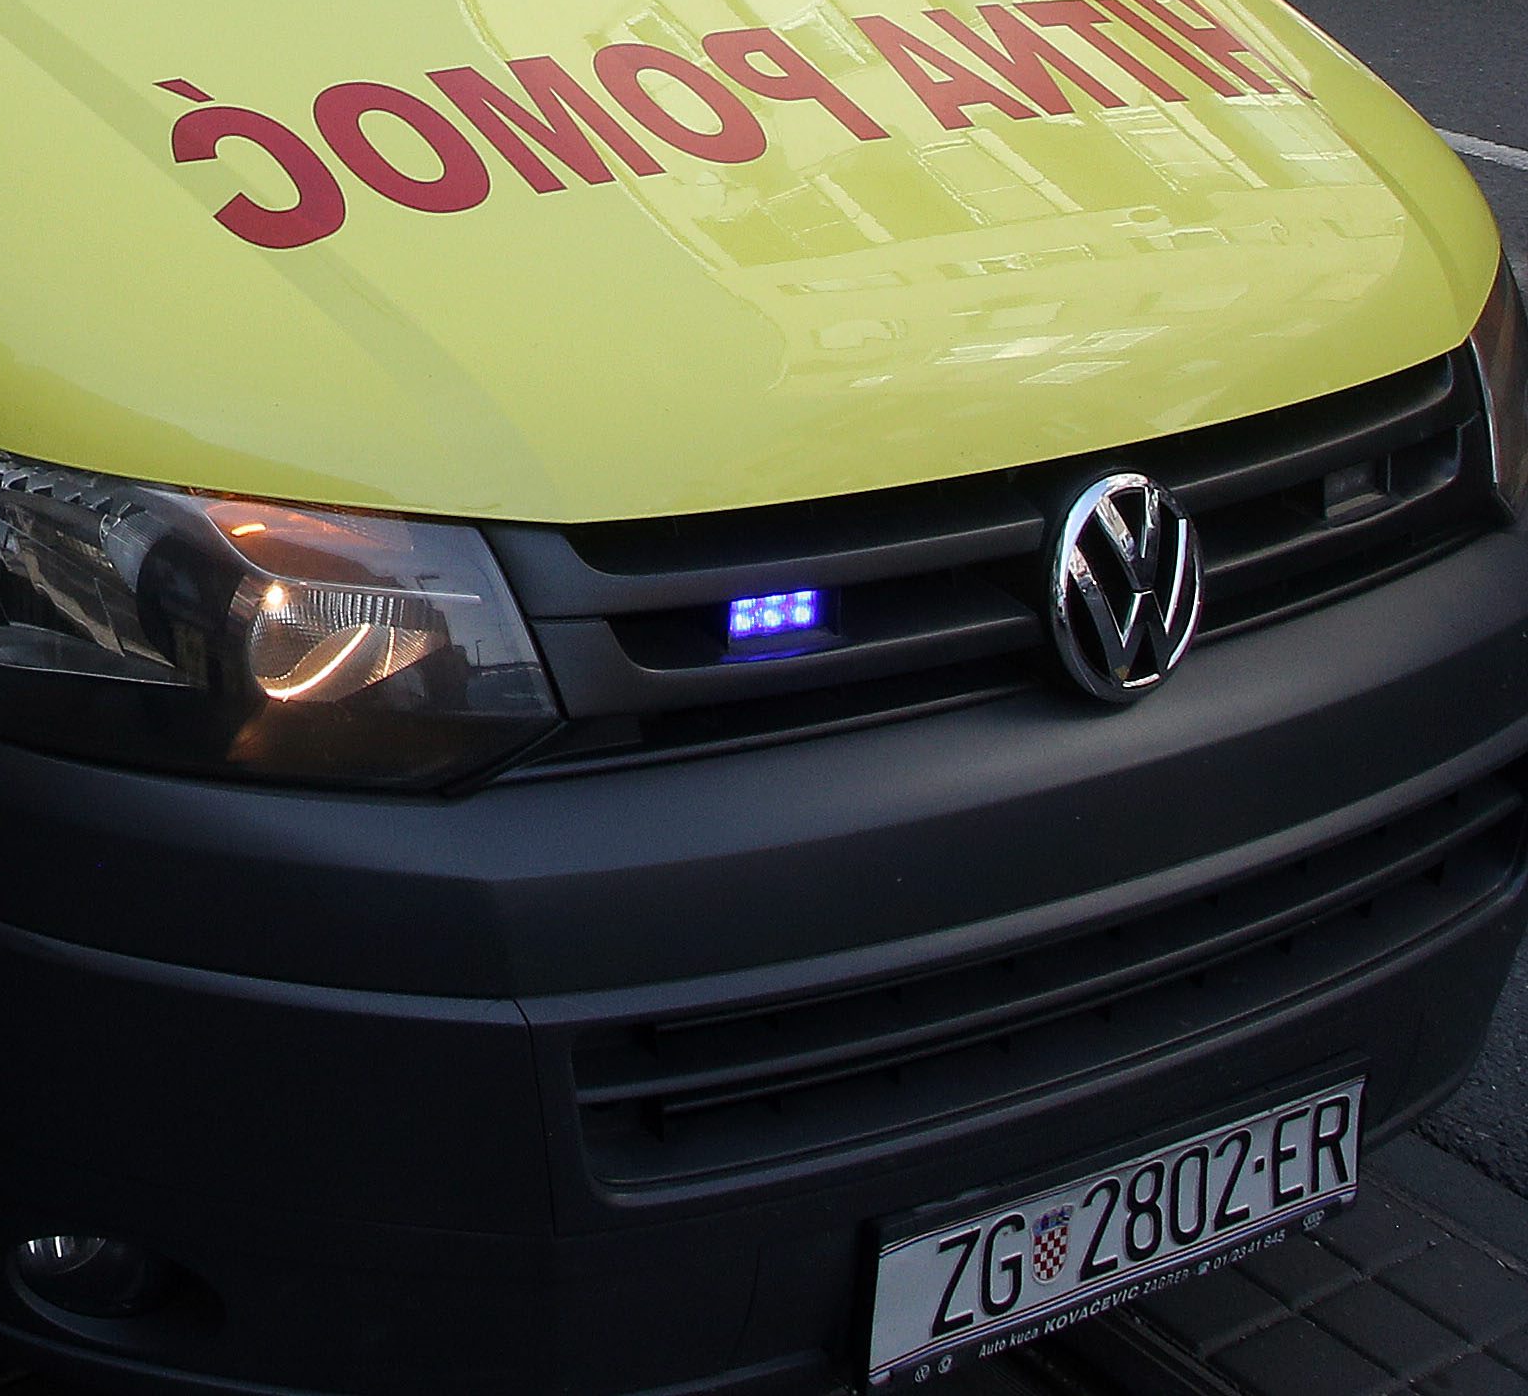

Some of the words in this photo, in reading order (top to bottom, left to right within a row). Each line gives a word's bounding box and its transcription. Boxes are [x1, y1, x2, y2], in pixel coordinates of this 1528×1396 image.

[931, 1212, 1025, 1339] ZG
[1079, 1094, 1352, 1281] 2802-ER
[978, 1339, 1006, 1359] Auto
